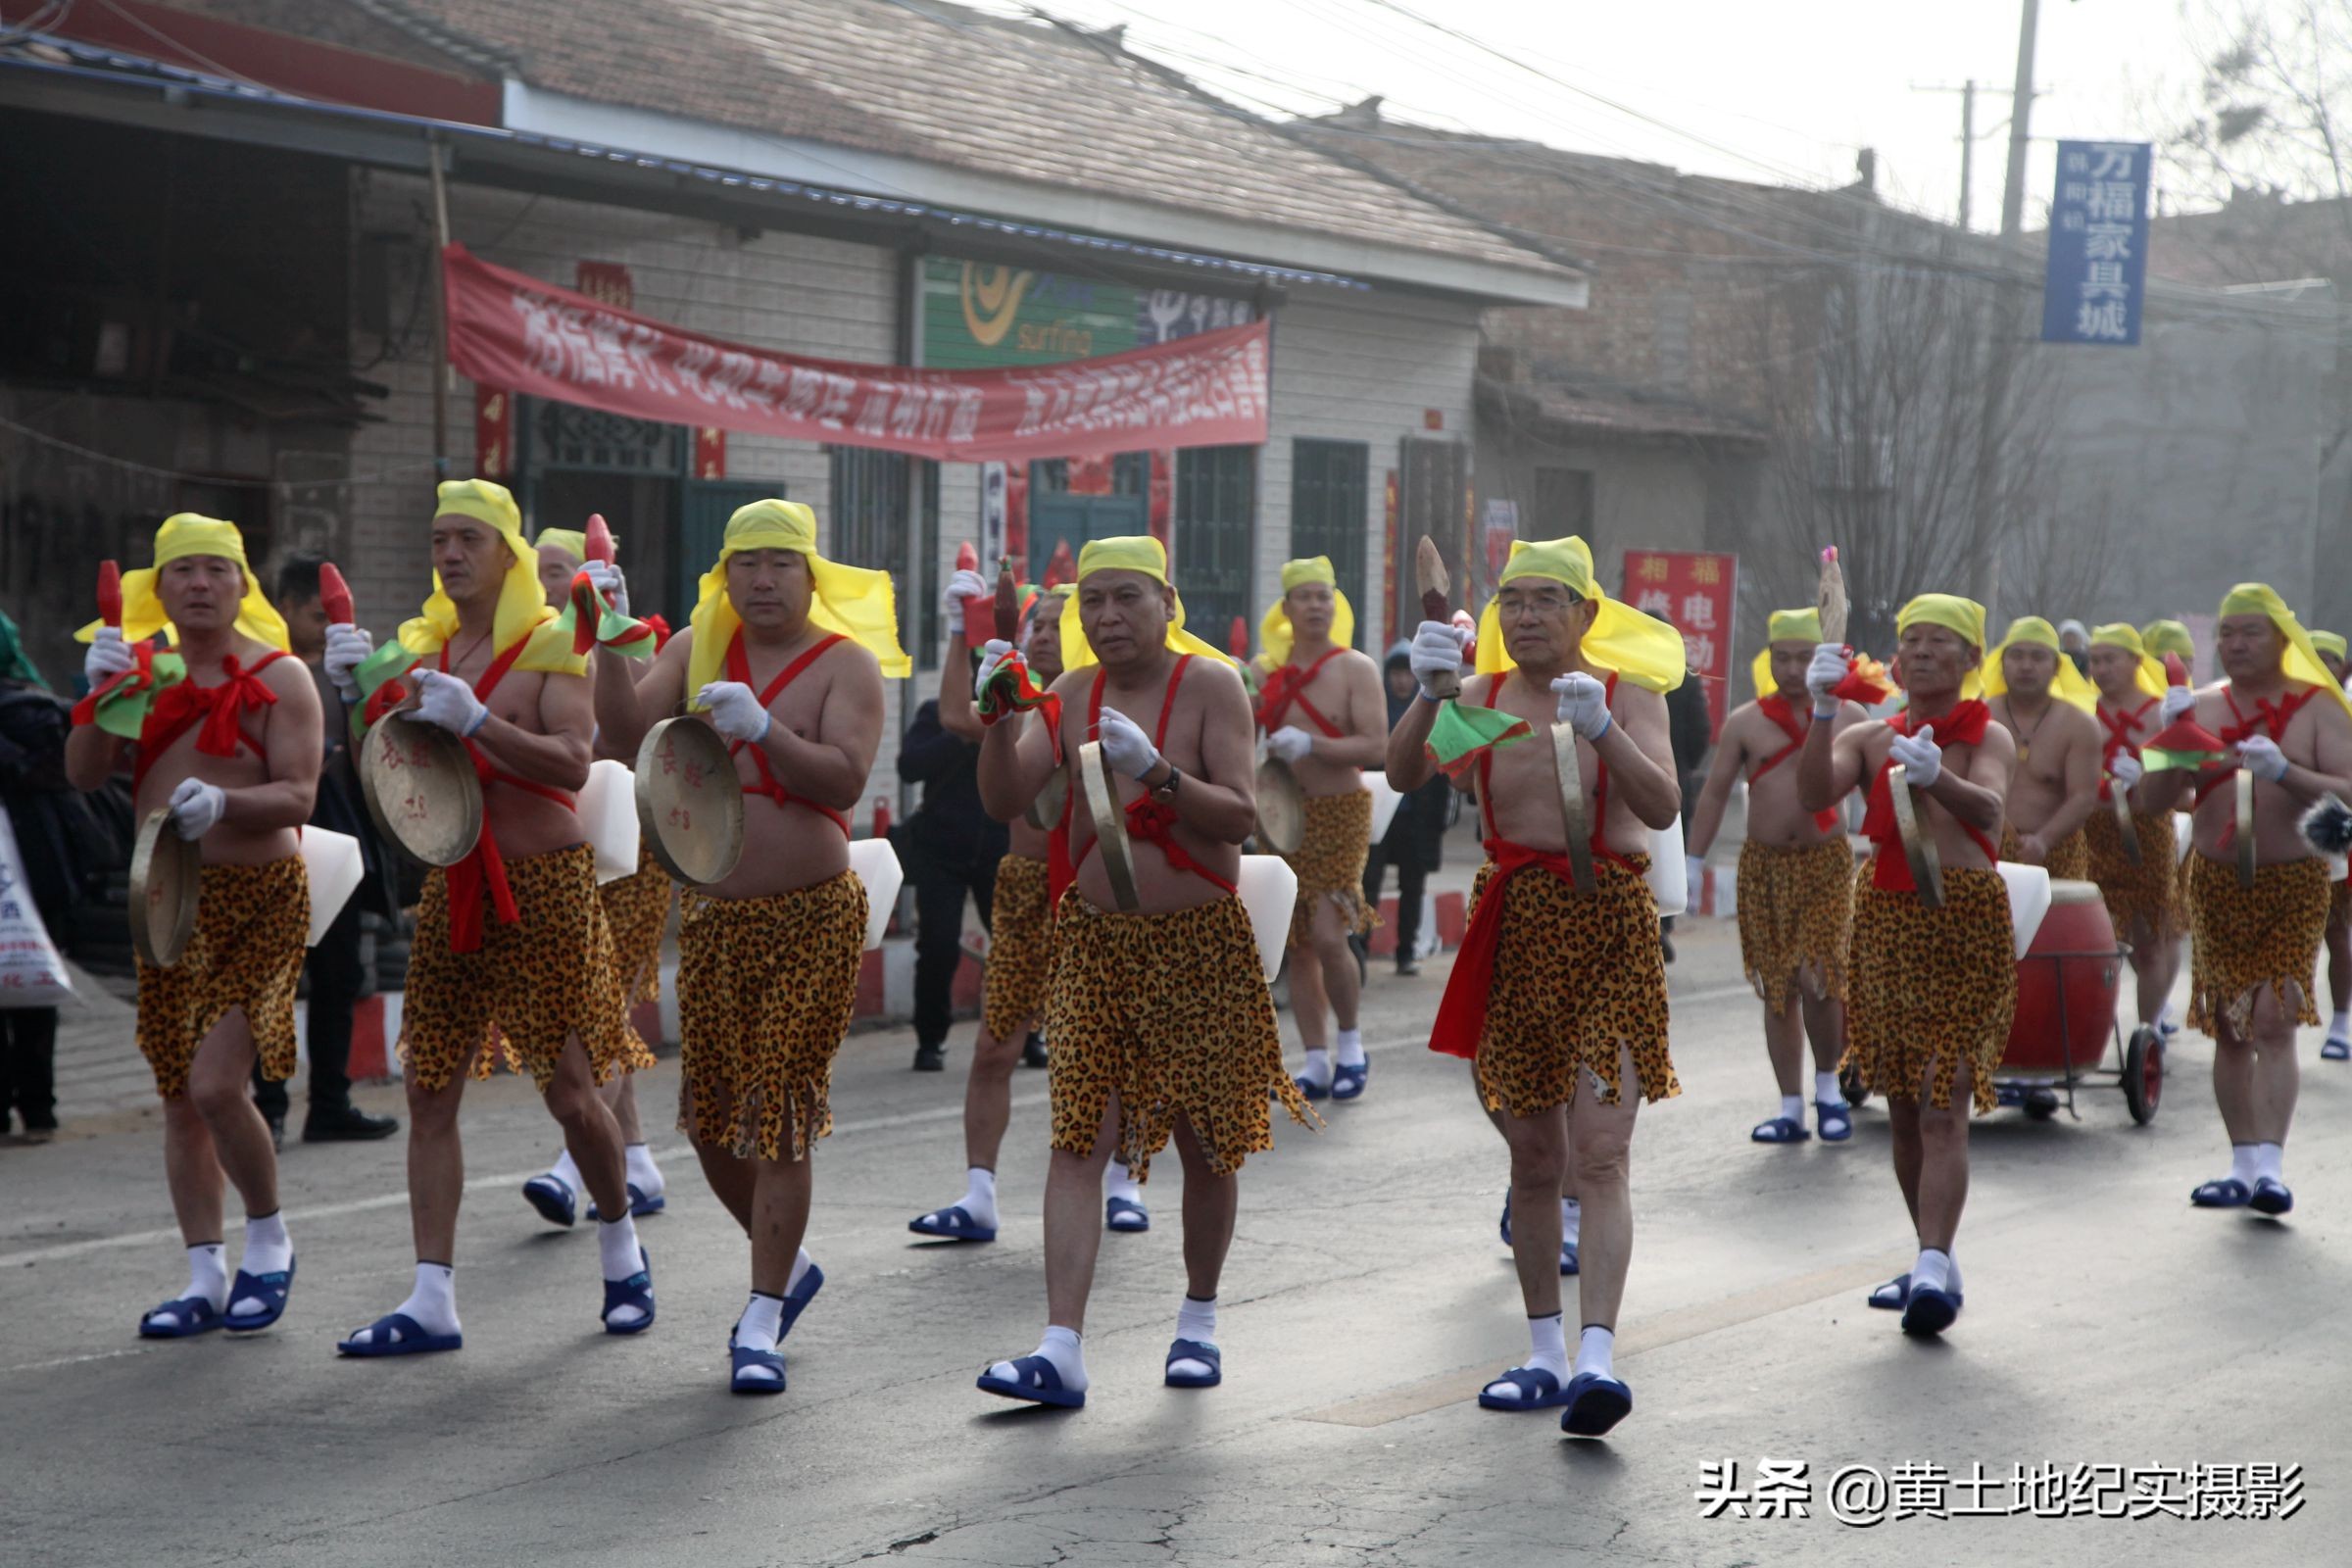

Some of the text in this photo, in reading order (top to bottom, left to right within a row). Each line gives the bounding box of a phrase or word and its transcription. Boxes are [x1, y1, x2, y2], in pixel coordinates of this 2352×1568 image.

[2077, 144, 2139, 340] 万福家具城
[1017, 318, 1094, 357] surfing
